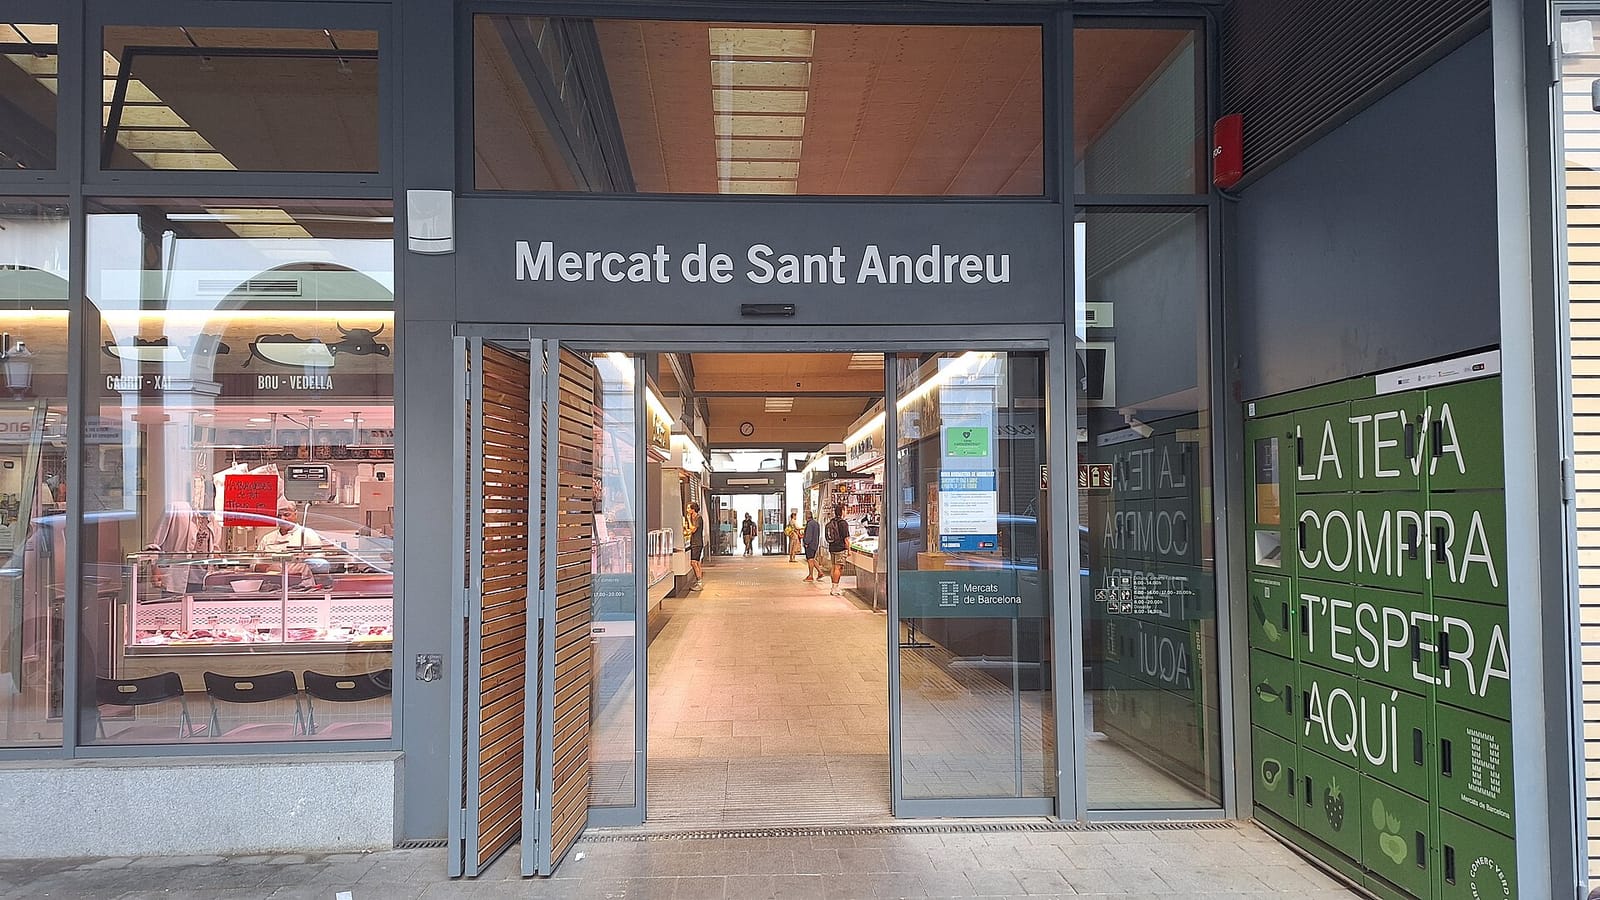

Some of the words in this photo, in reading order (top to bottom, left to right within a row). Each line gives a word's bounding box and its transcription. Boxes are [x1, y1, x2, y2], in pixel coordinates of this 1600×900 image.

[515, 240, 670, 284] Mercat
[681, 243, 734, 284] de
[746, 244, 846, 284] Sant
[856, 244, 1011, 284] Andreu
[106, 375, 143, 391] CABRIT
[258, 375, 279, 390] BOU
[290, 375, 333, 390] VEDELLA
[1297, 420, 1342, 481] LA
[1349, 403, 1466, 479] TEVA
[1298, 510, 1498, 587] COMPRA
[963, 584, 998, 592] Mercats
[963, 595, 975, 604] de
[978, 595, 1022, 604] Barcelona
[1300, 594, 1509, 697] T'ESPERA
[1305, 681, 1398, 773] AQUÍ
[1461, 793, 1478, 807] Mercats
[1486, 804, 1510, 820] Barcelona
[1470, 856, 1494, 878] COMERÇ
